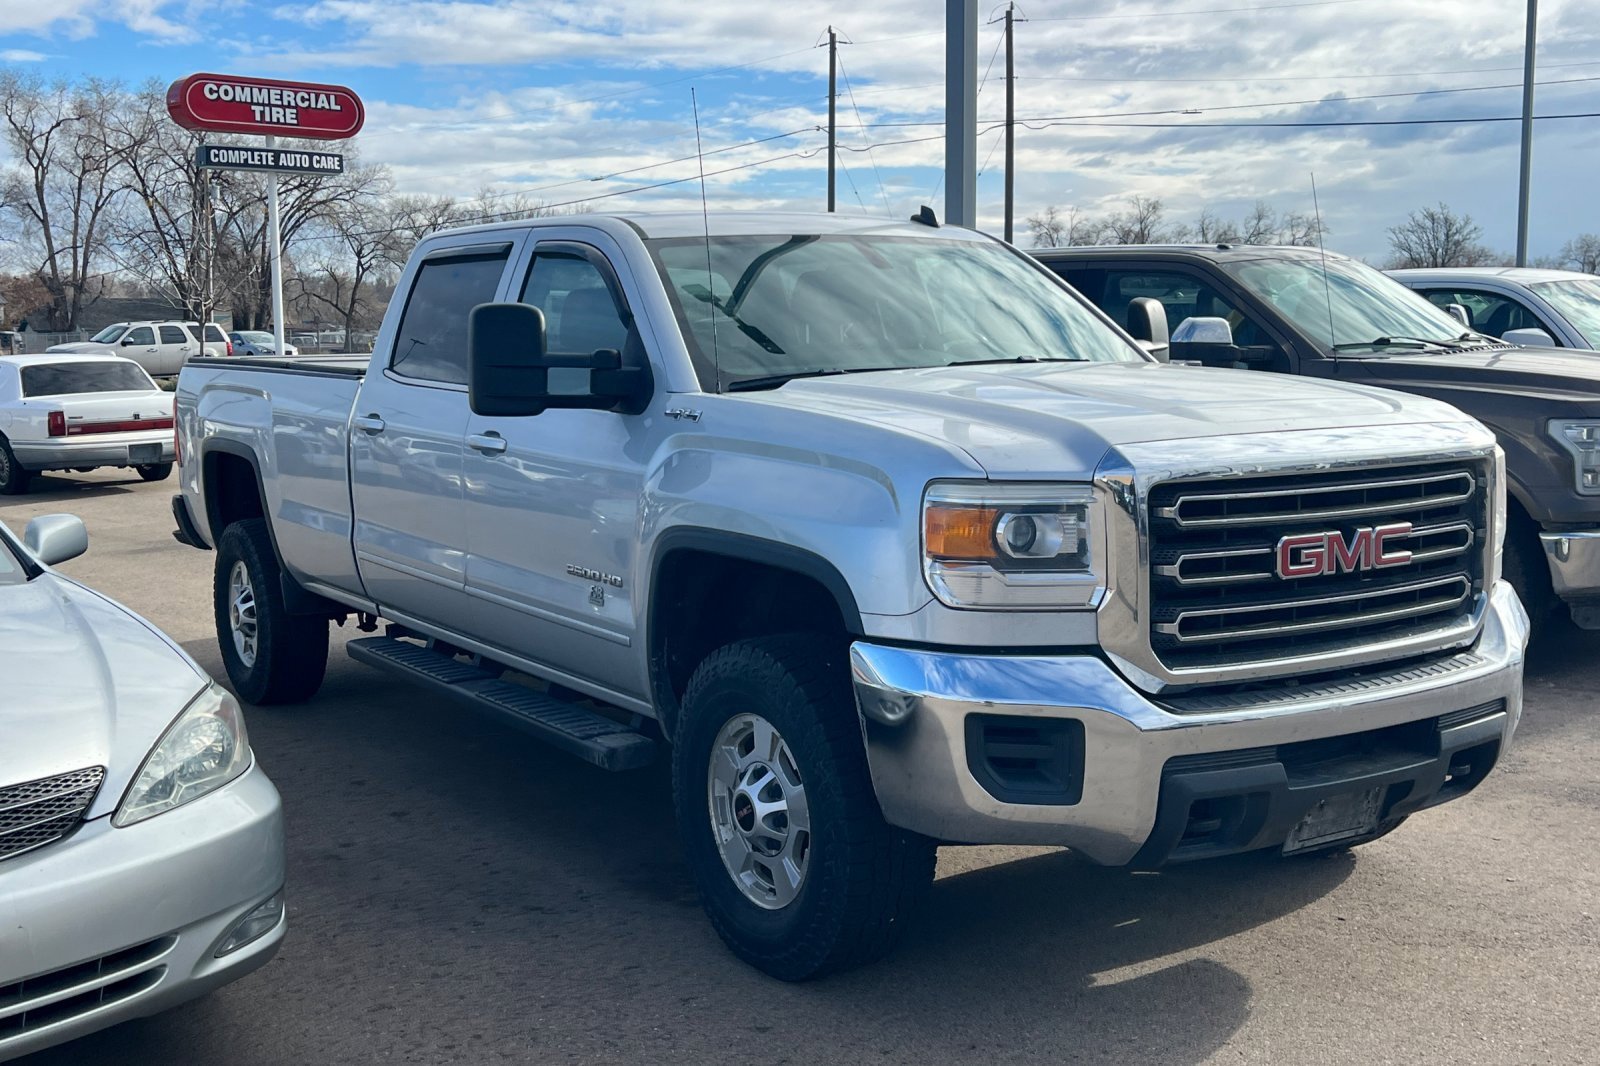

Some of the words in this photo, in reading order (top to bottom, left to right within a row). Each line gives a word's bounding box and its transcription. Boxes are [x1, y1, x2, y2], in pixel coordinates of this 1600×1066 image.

[203, 83, 341, 111] COMMERCIAL
[251, 105, 298, 125] TIRE
[210, 149, 275, 166] COMPLETE
[279, 153, 309, 168] AUTO
[313, 155, 341, 170] CARE
[1276, 521, 1413, 581] GMC
